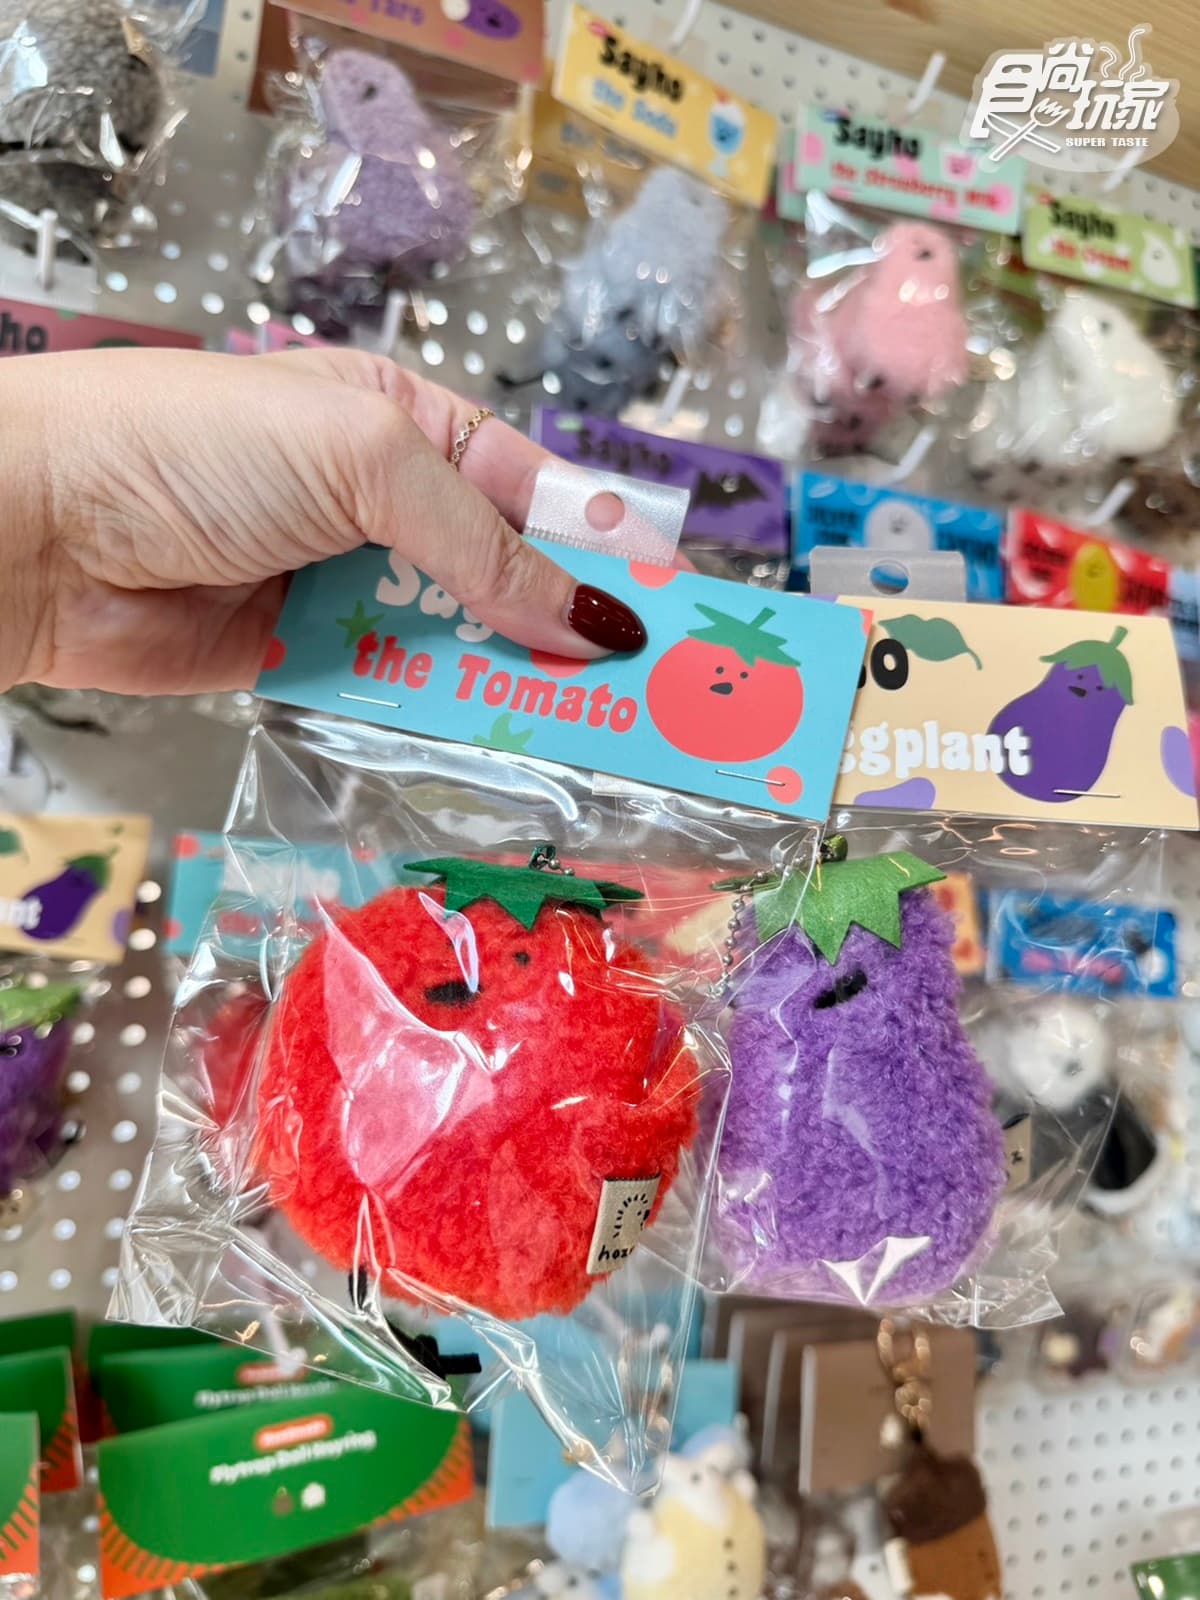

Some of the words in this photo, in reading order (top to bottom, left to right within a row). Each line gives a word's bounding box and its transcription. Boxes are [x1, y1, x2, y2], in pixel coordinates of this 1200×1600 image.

[600, 36, 683, 104] Sayho
[834, 116, 922, 161] Sayho
[1049, 200, 1116, 241] Sayho
[352, 631, 433, 689] the
[455, 653, 638, 733] Tomato
